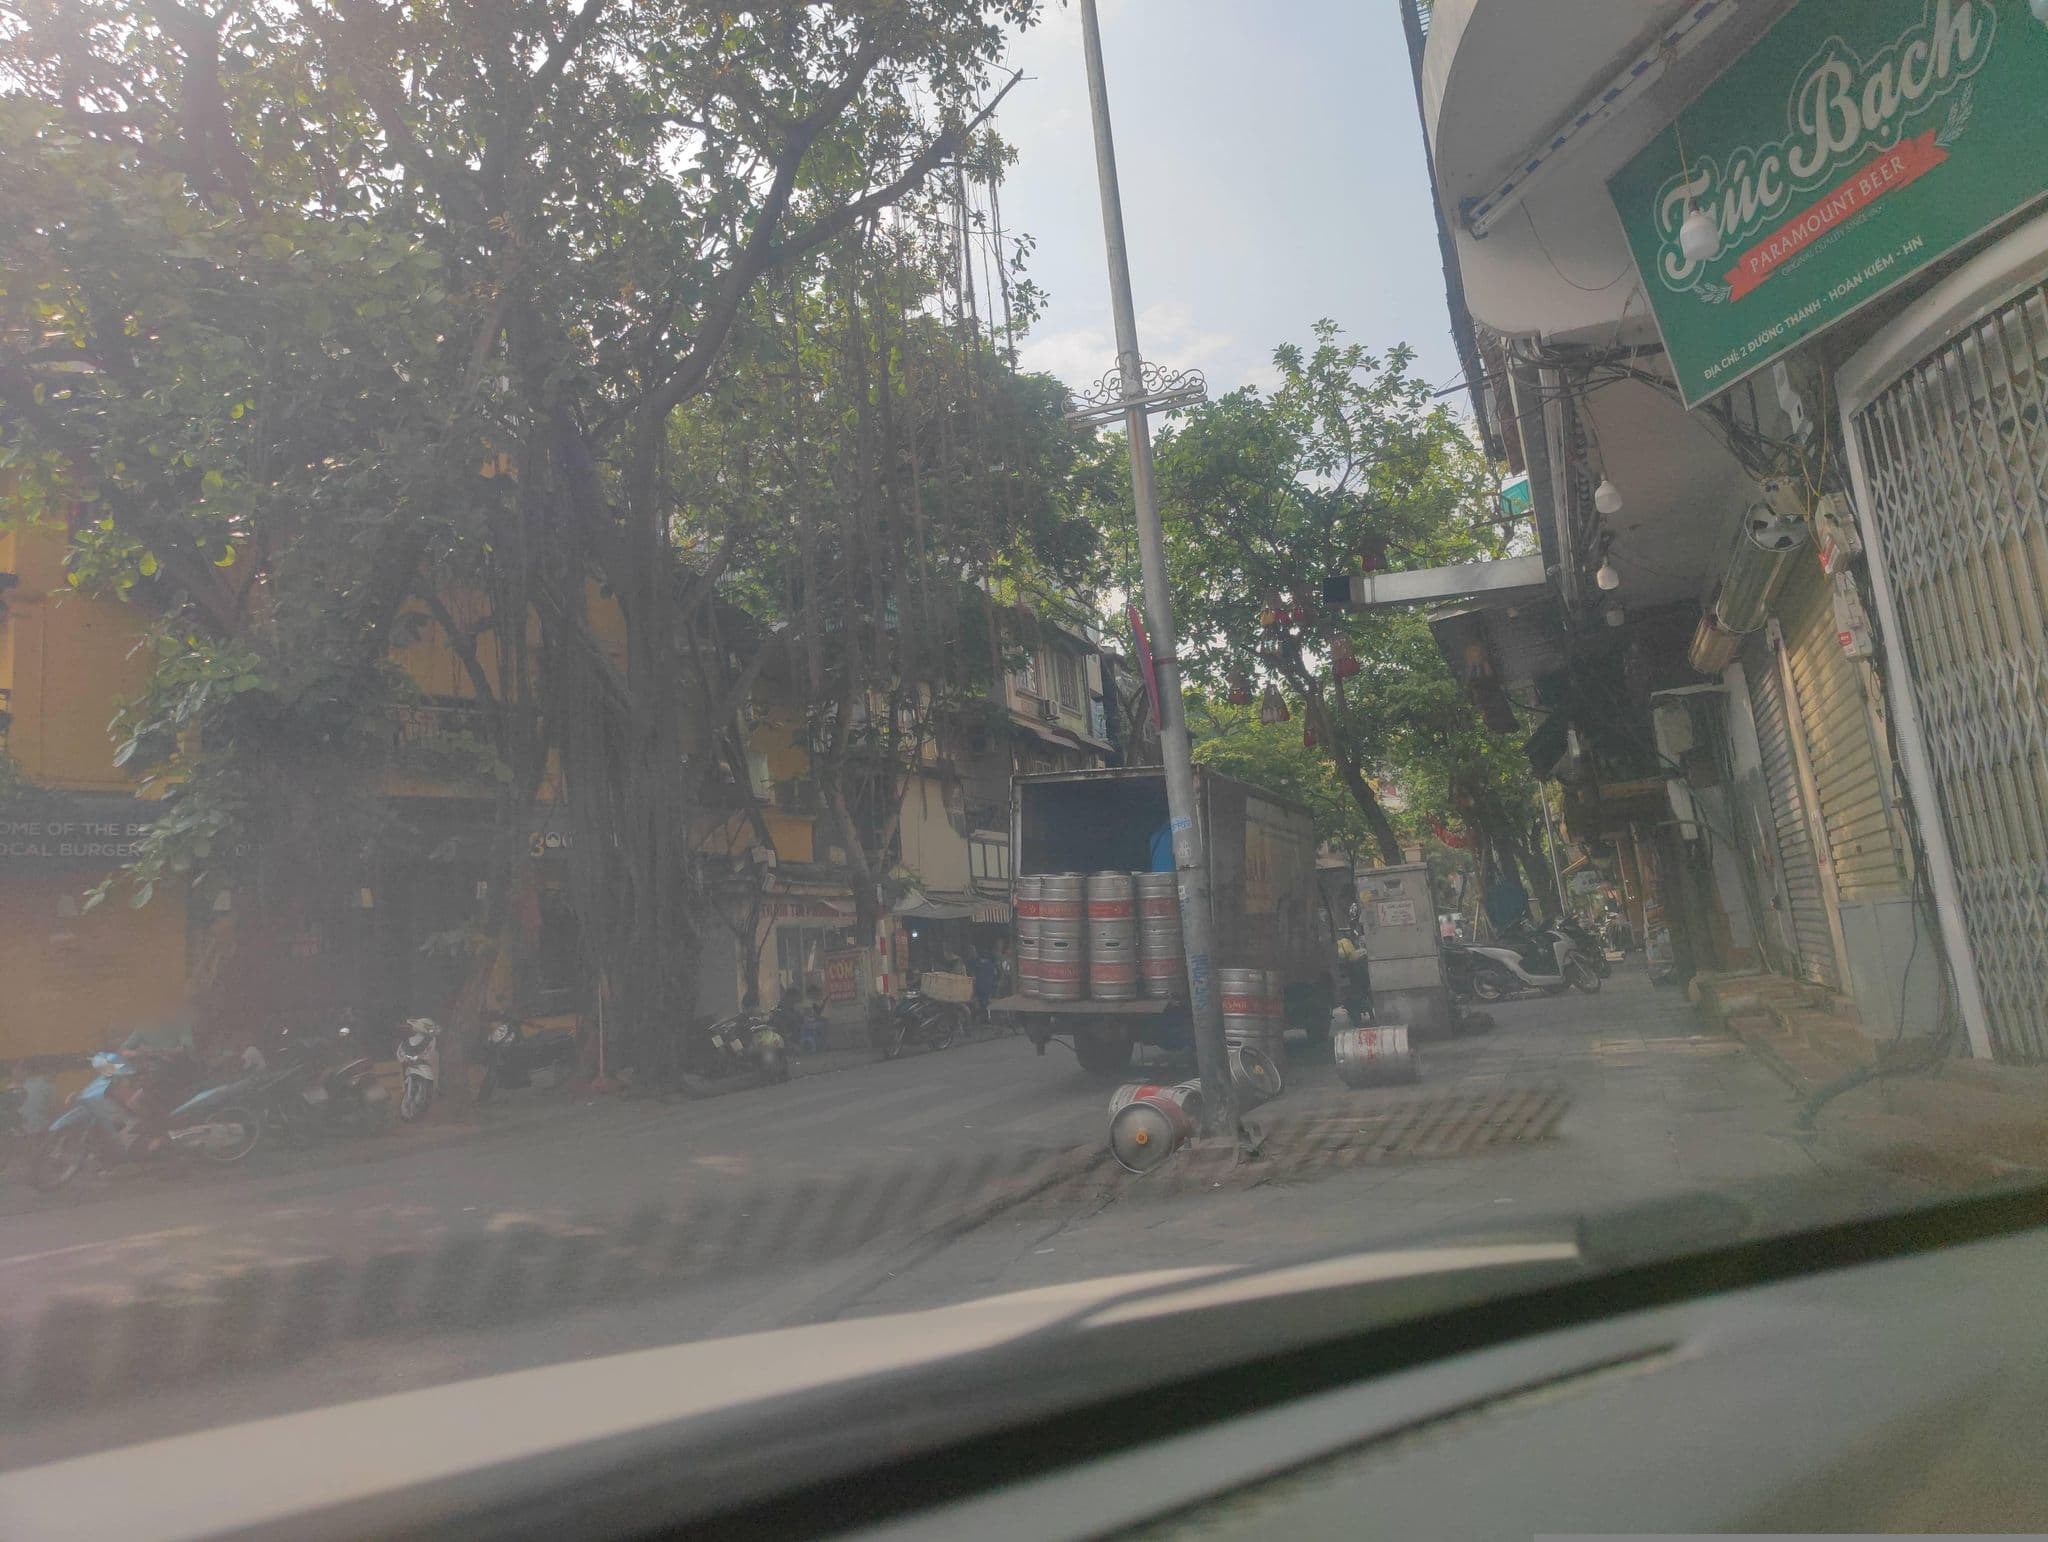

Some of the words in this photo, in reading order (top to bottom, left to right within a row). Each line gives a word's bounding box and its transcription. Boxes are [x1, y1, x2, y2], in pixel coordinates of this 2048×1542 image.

[1789, 0, 1982, 177] Bạch
[1750, 188, 1855, 272] PARAMOUNT
[1858, 155, 1905, 196] BEER
[1703, 364, 1721, 380] ĐỊA
[1741, 346, 1749, 358] 2
[1747, 324, 1784, 352] ĐƯỜNG
[1828, 273, 1863, 302] HOÀN
[1902, 235, 1924, 255] HN
[48, 822, 78, 836] OF
[81, 822, 120, 836] THE
